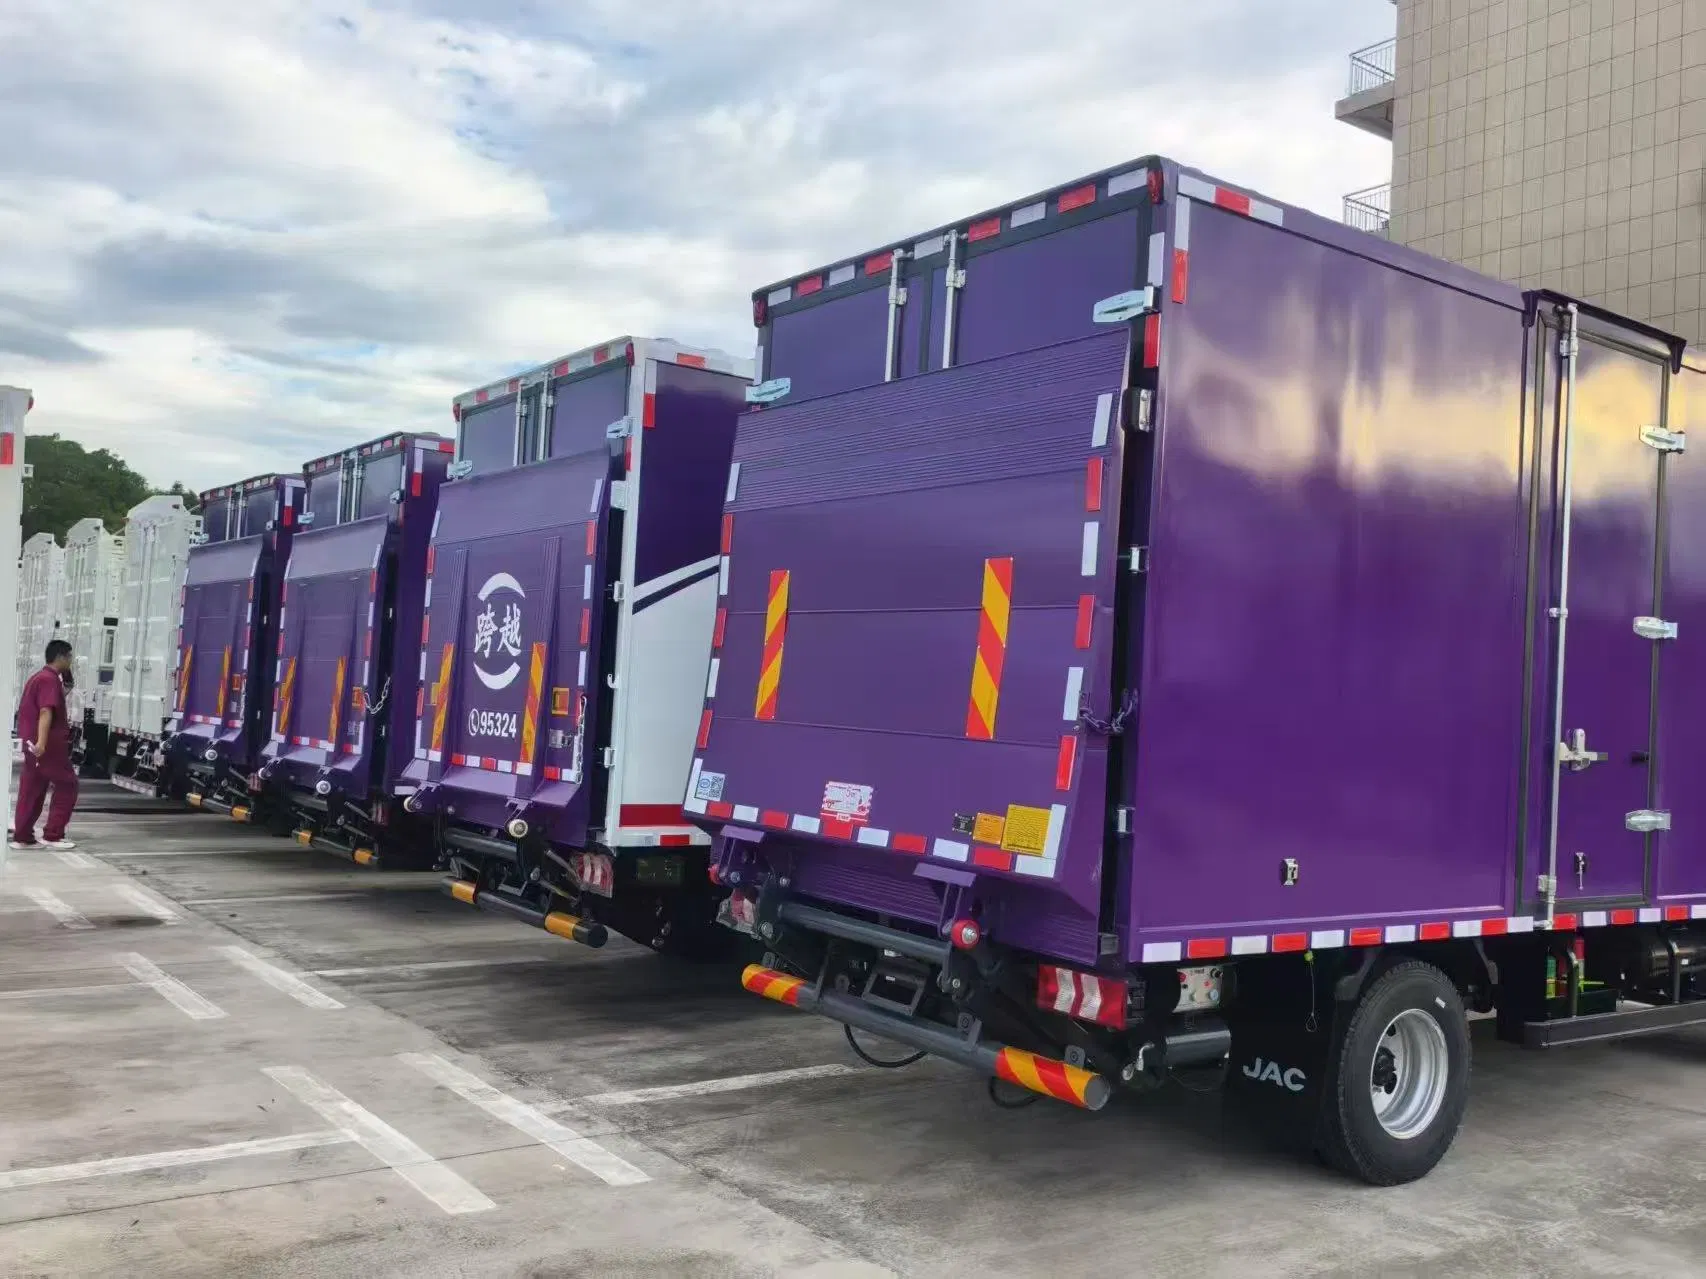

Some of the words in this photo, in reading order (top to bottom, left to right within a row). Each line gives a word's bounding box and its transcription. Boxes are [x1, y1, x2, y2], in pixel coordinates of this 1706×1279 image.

[474, 602, 522, 658] 跨越
[479, 711, 517, 738] 95324
[1242, 1057, 1306, 1091] JAC
